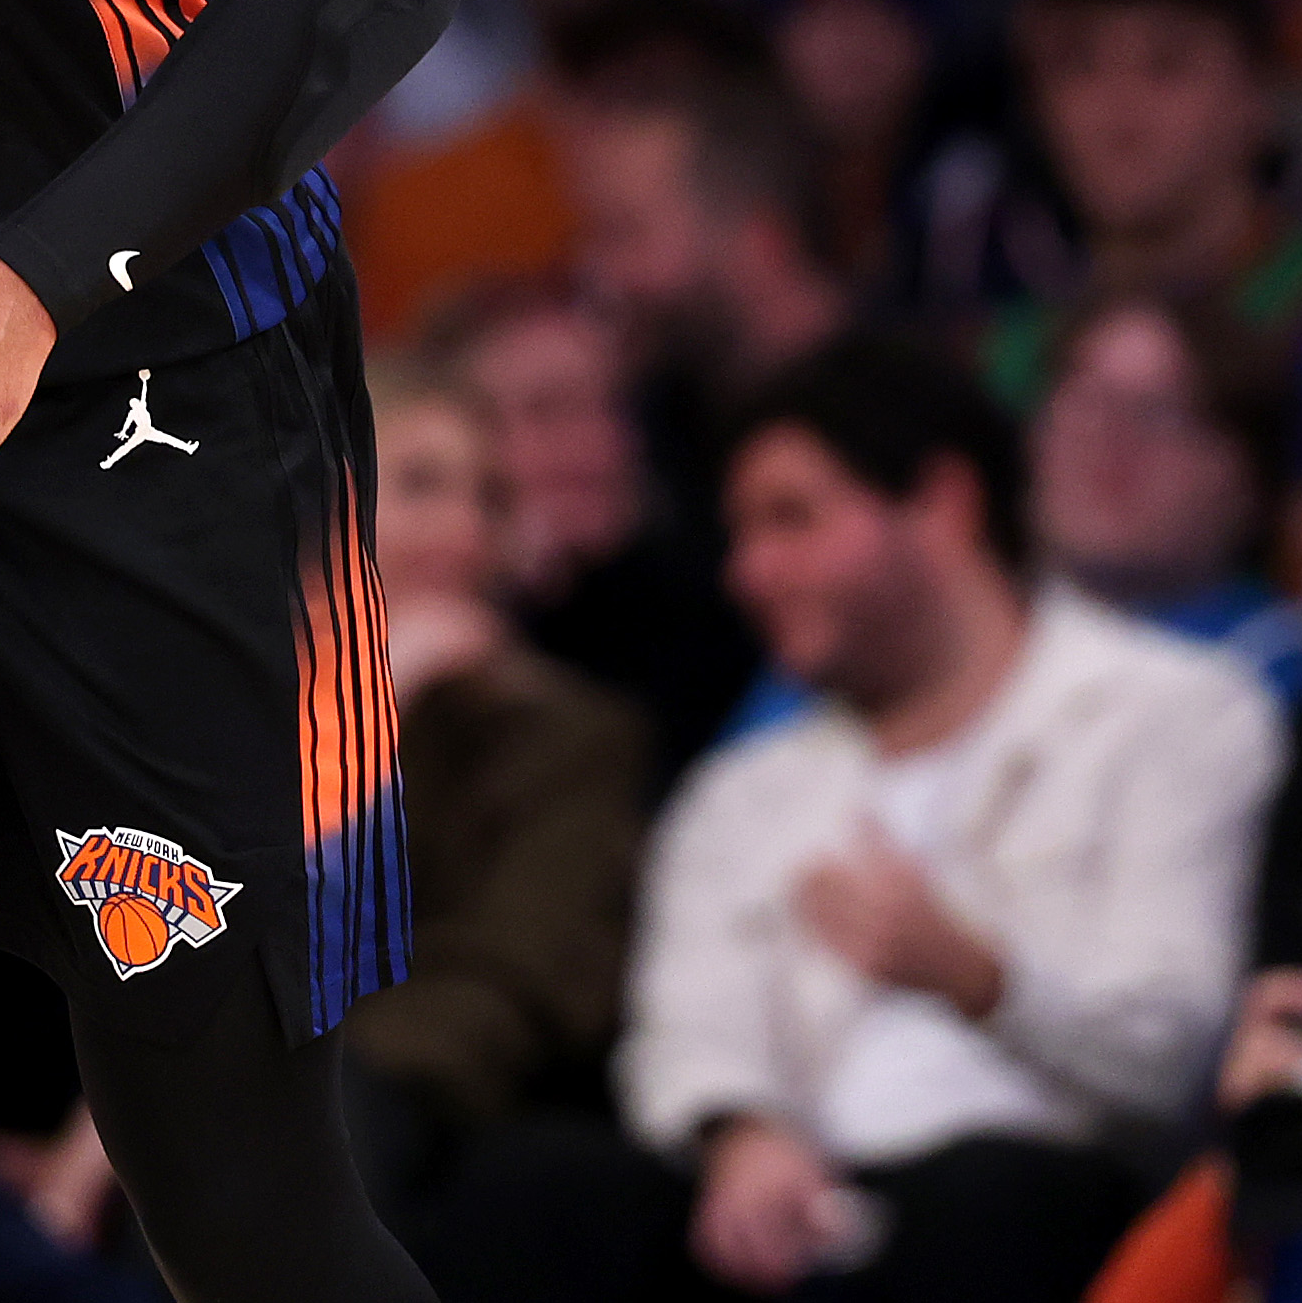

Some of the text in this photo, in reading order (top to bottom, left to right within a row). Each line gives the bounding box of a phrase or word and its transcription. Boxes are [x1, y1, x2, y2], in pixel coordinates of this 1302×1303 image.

[115, 832, 180, 863] NEW YORK
[61, 834, 221, 930] KNICKS
